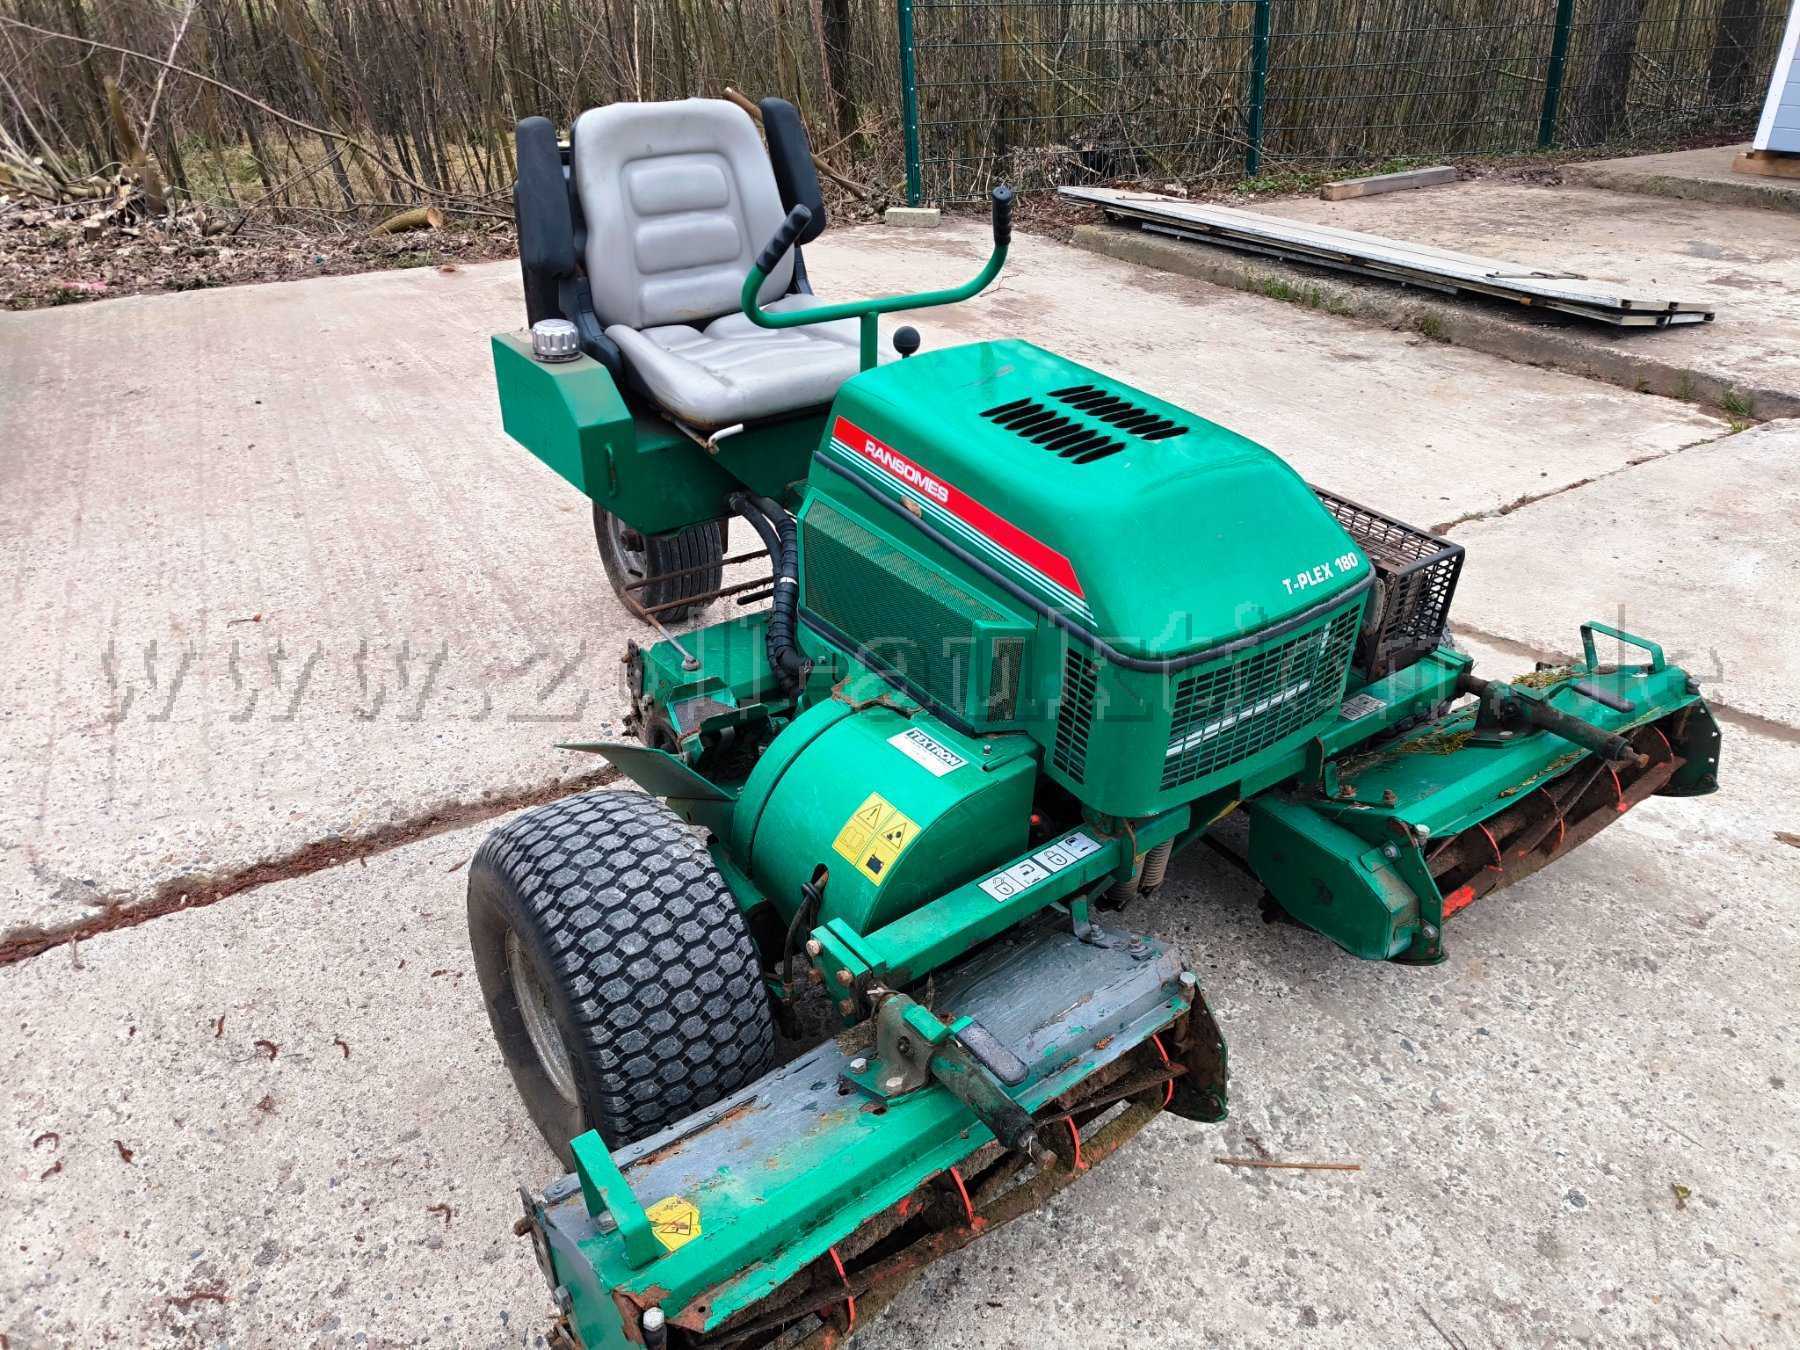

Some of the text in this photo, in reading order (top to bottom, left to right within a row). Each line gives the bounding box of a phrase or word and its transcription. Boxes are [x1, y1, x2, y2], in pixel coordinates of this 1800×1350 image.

[865, 440, 949, 502] RANSOMES
[1282, 552, 1359, 595] T-PLEX 180
[906, 729, 963, 767] TEXTRON
